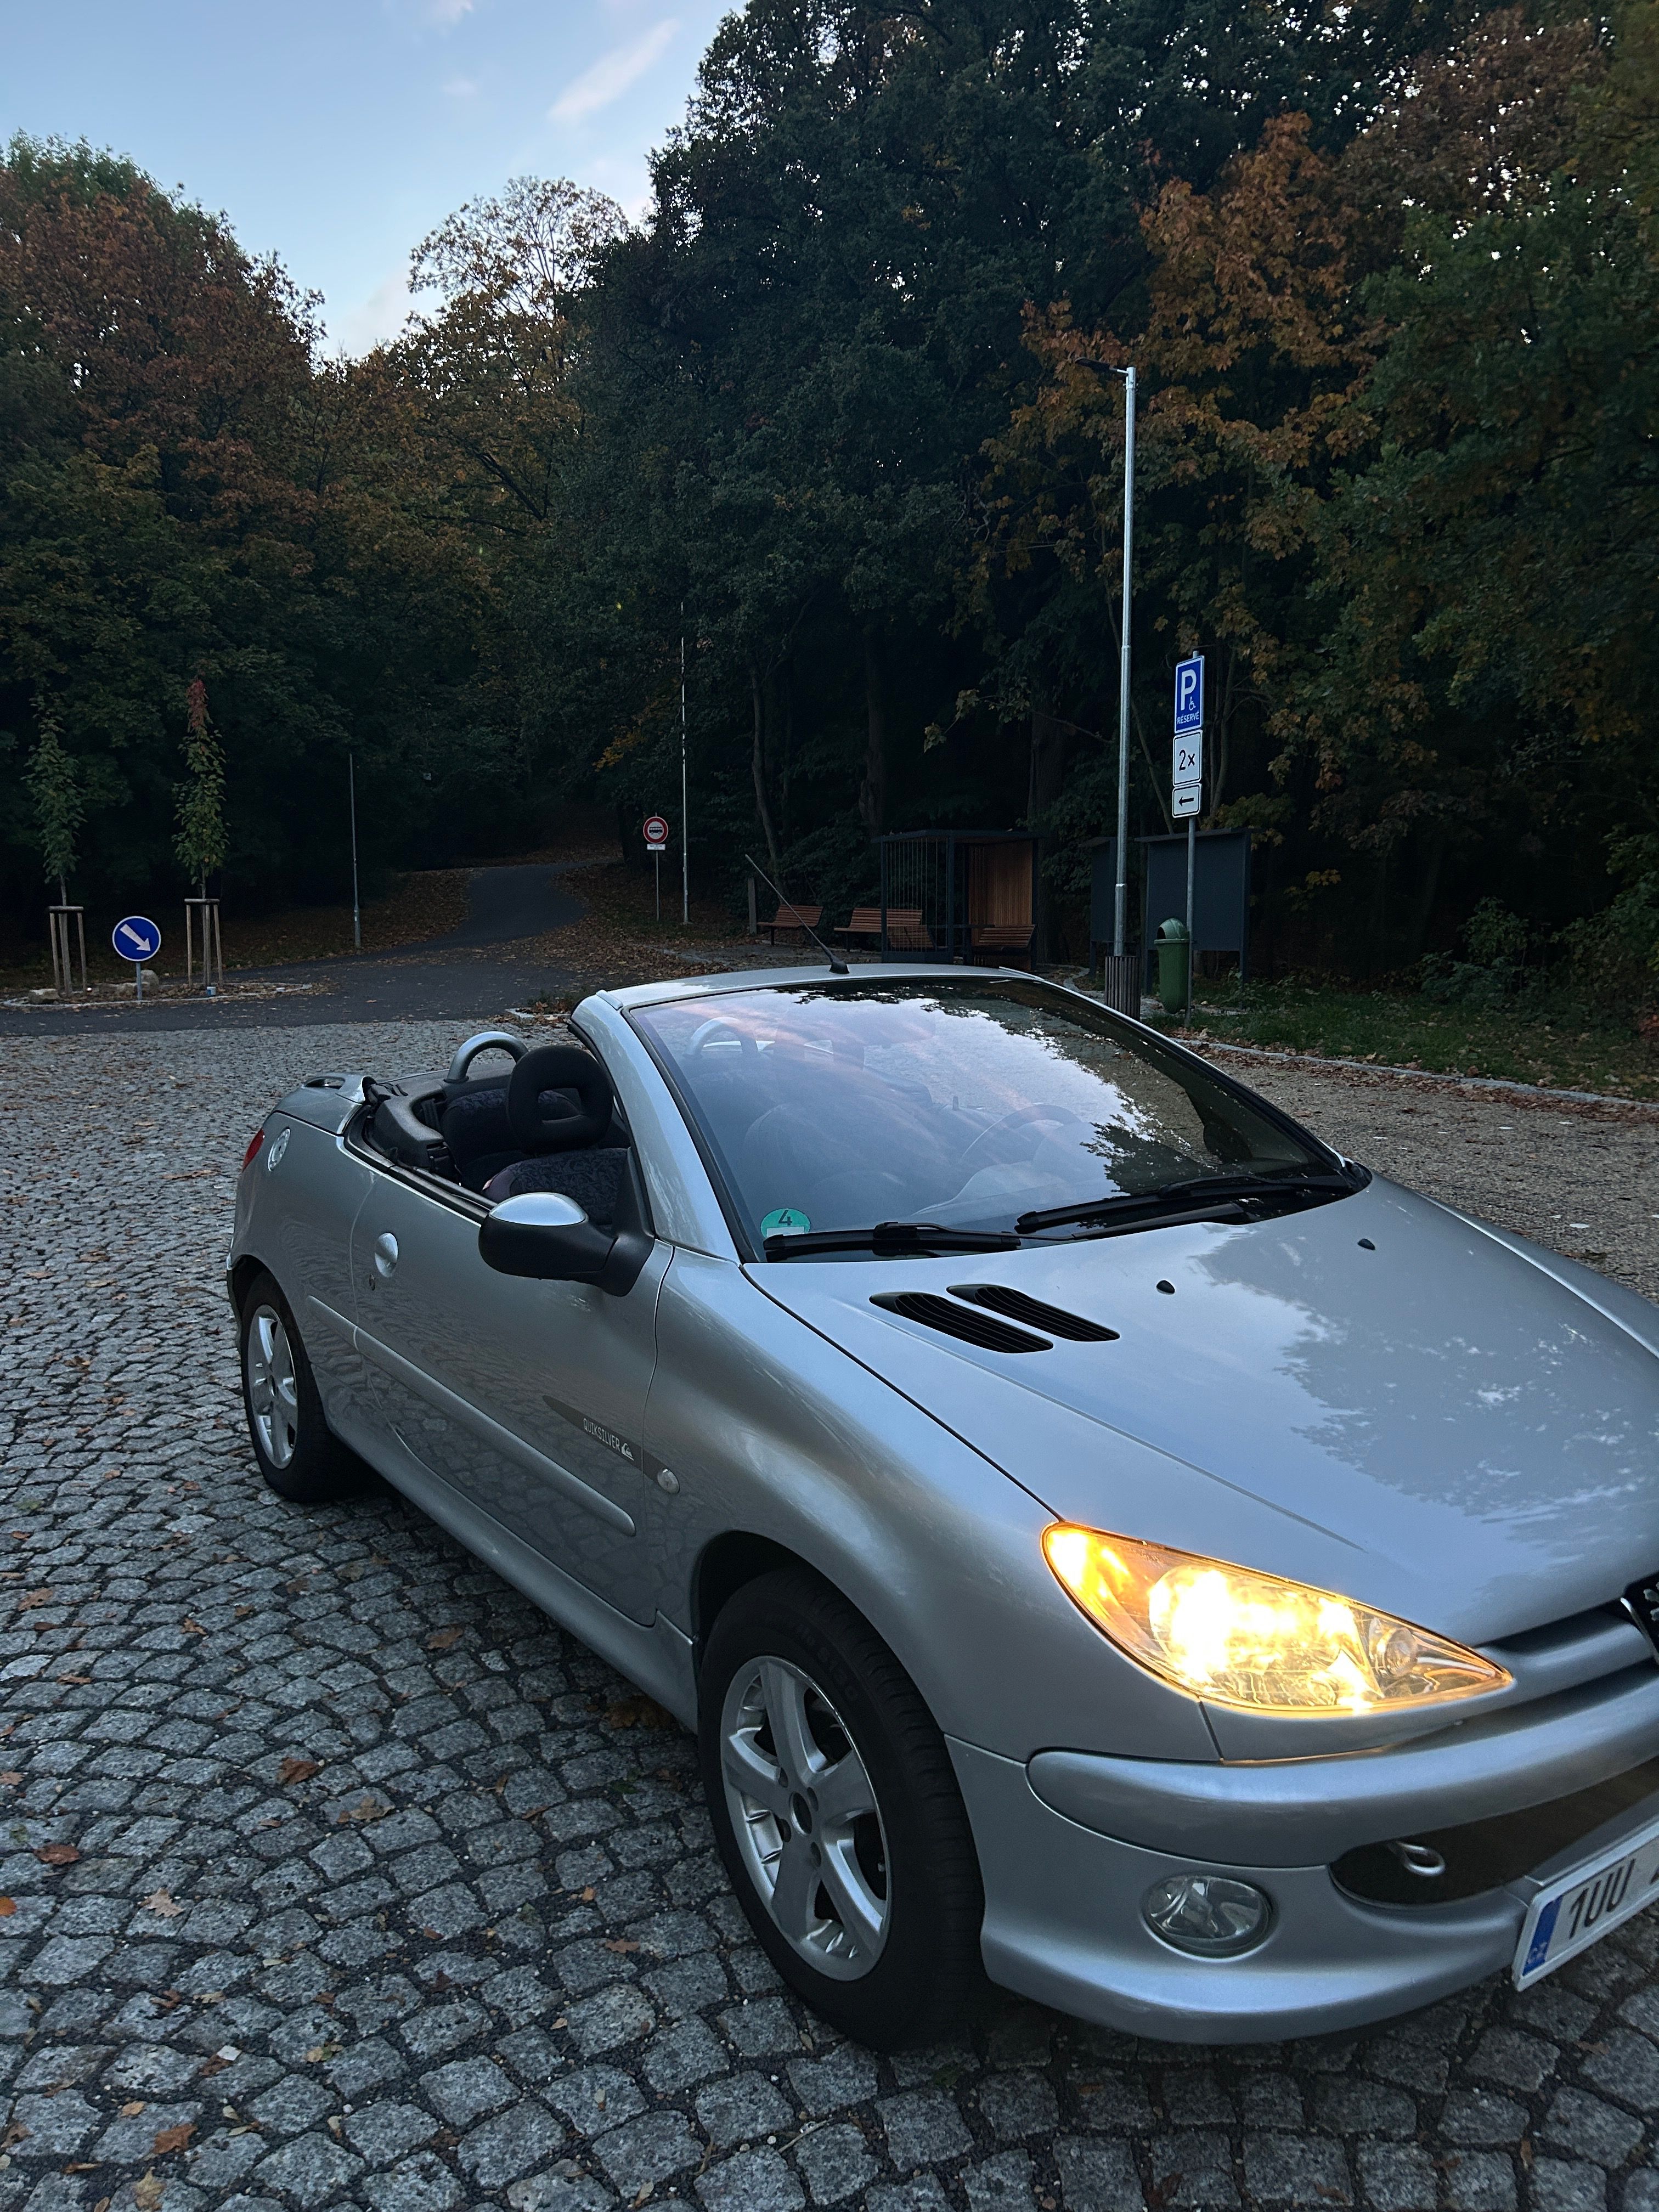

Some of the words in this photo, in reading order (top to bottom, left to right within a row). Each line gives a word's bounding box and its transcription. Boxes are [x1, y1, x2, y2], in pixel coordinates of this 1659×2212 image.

[1181, 669, 1197, 711] P
[1177, 710, 1199, 725] RÉSERVÉ
[1179, 749, 1195, 771] 2x
[778, 1210, 792, 1226] 4
[583, 1418, 620, 1452] QUIKSILVER
